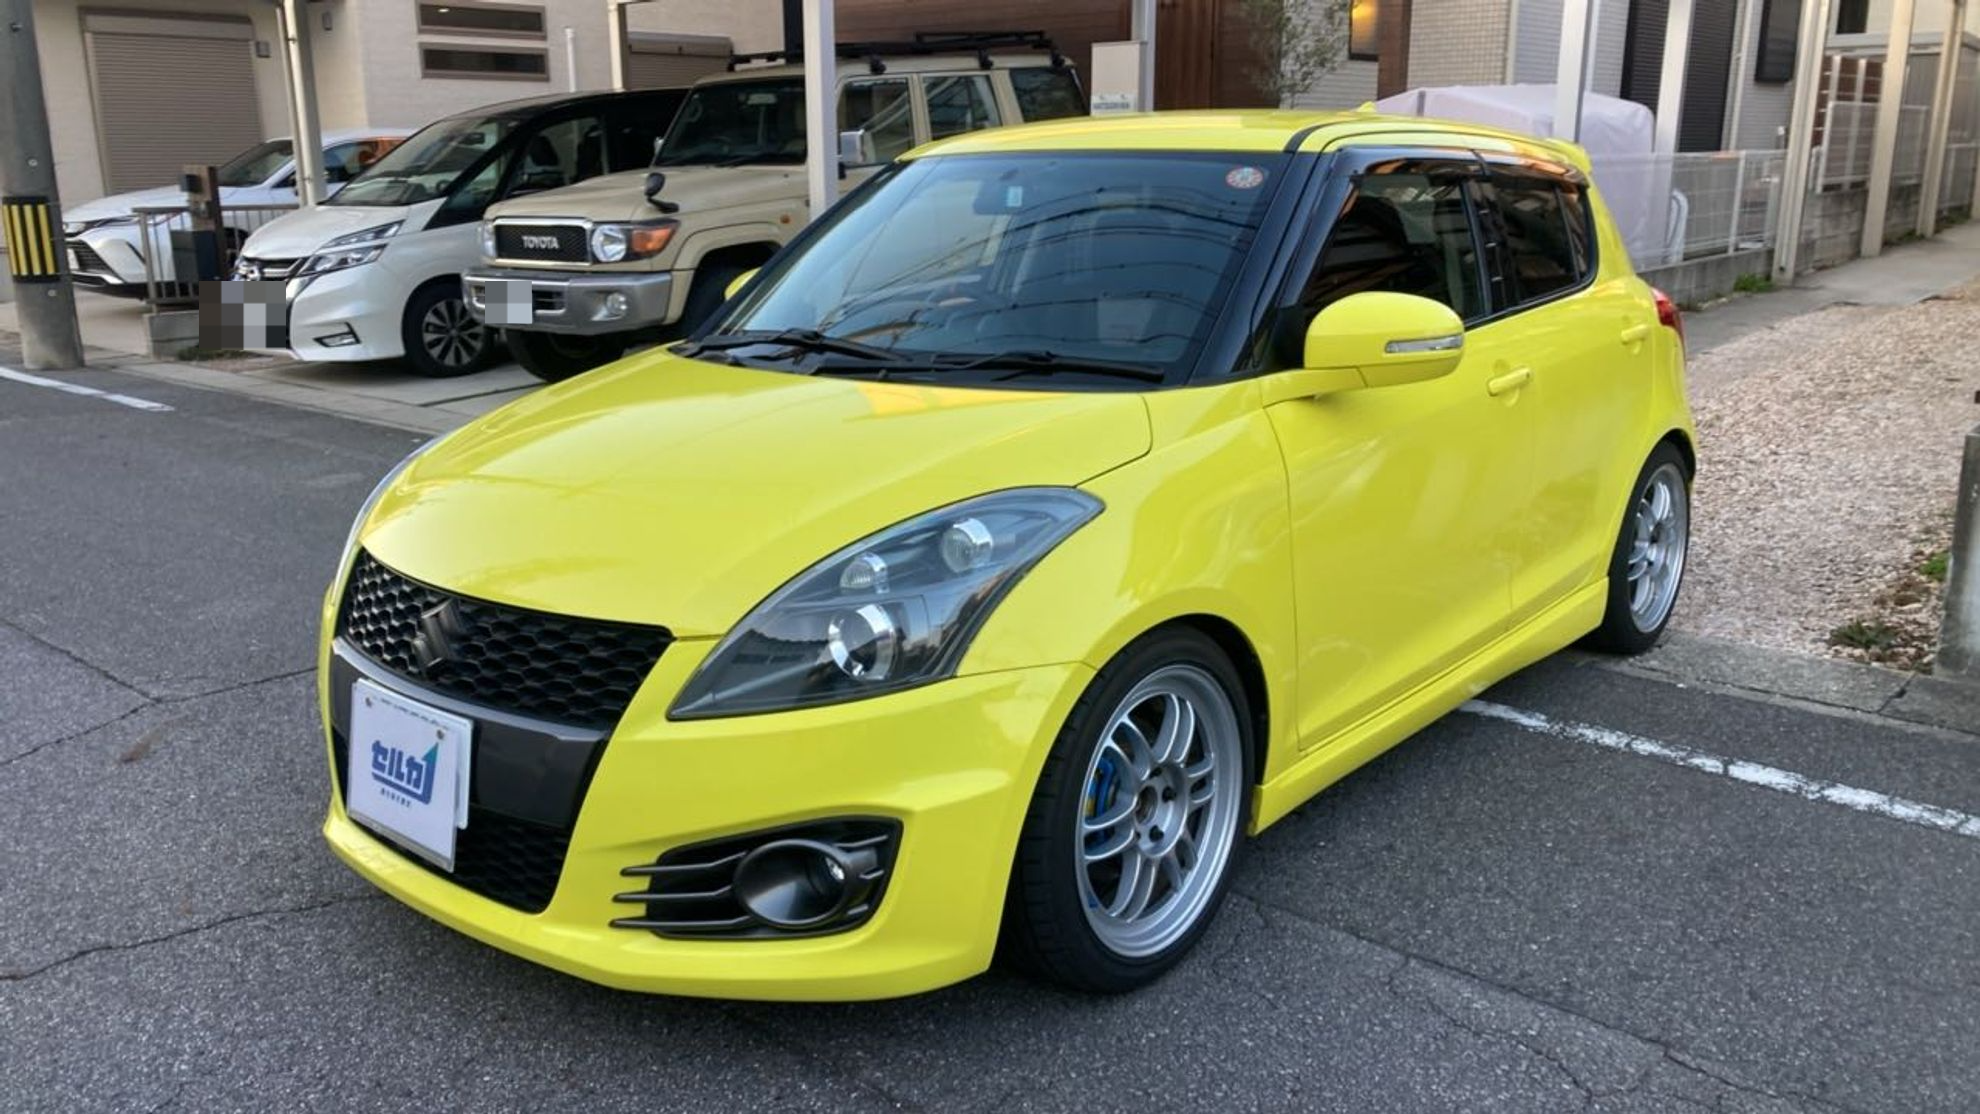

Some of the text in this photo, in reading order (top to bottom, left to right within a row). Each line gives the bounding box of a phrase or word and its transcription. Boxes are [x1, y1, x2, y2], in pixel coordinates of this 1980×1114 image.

[521, 235, 559, 249] TOYOTA
[371, 740, 425, 792] セルカ
